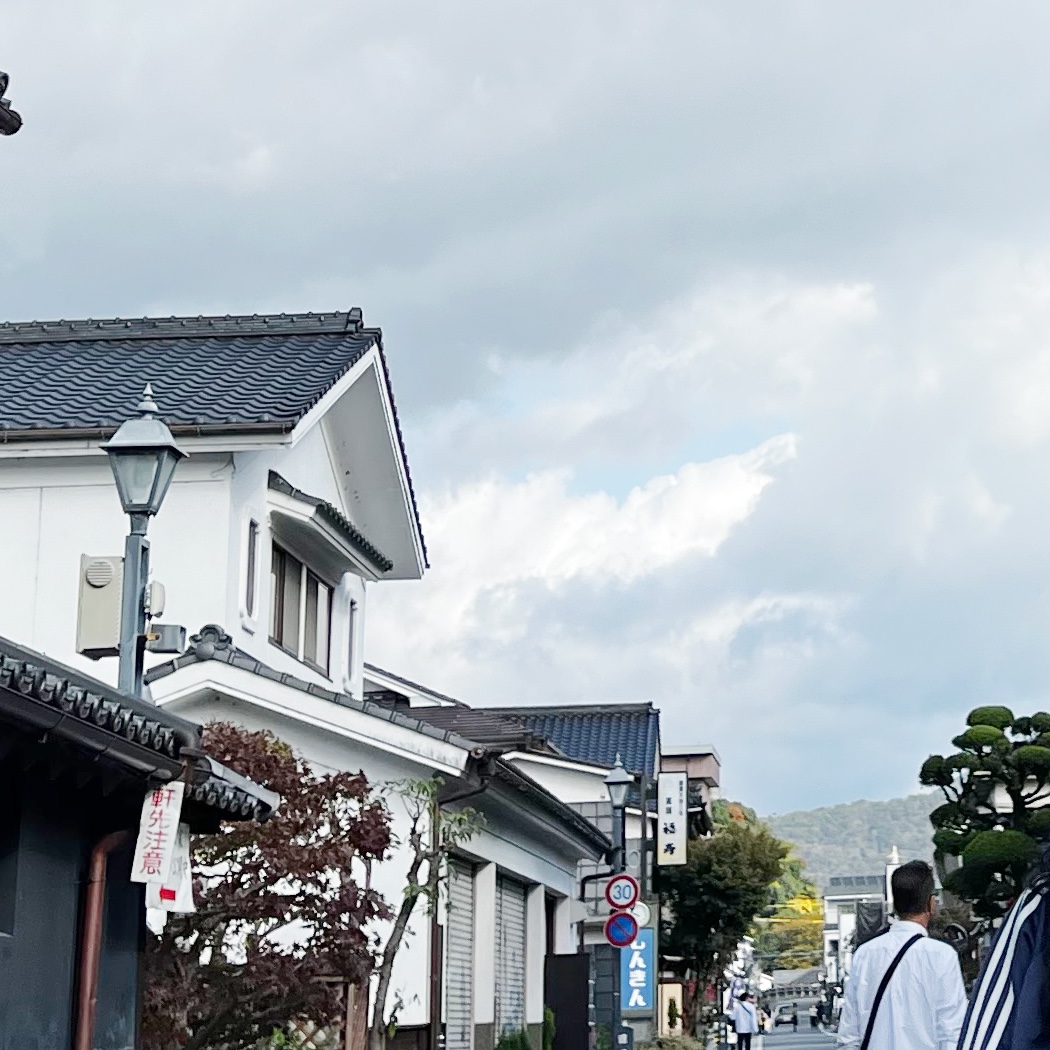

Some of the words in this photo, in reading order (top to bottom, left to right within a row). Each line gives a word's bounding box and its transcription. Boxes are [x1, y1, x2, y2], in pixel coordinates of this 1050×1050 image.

[139, 786, 175, 876] 軒先注意
[613, 884, 632, 900] 30
